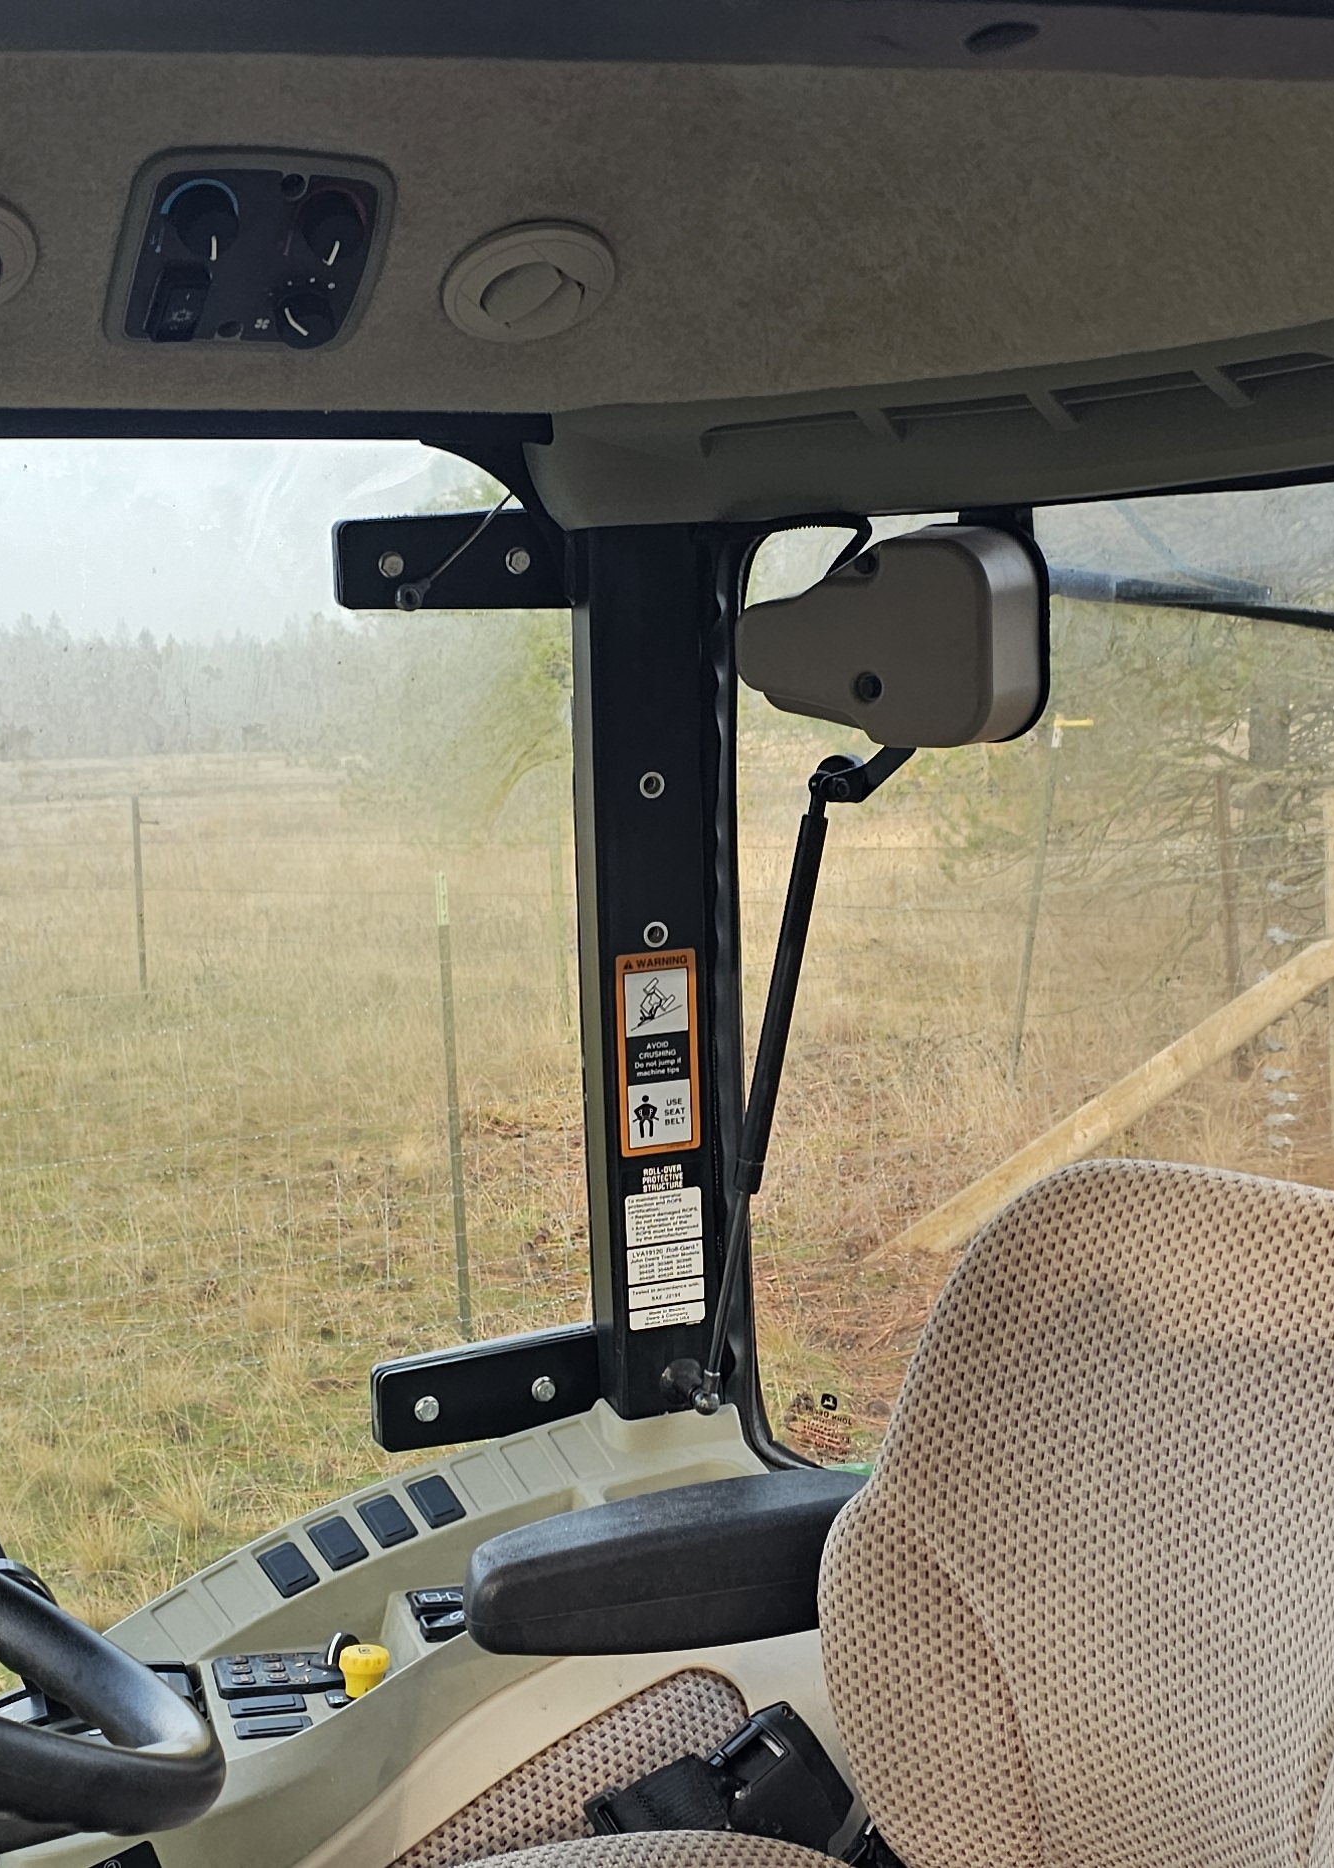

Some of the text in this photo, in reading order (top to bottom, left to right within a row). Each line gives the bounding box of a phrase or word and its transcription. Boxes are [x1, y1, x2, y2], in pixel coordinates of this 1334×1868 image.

[636, 955, 687, 968] WARNING
[646, 1041, 669, 1050] AVOID
[639, 1049, 676, 1059] CRUSHING
[658, 1059, 675, 1067] jump
[637, 1069, 665, 1077] machine
[666, 1098, 682, 1106] USE
[664, 1107, 685, 1116] SEAT
[665, 1117, 685, 1126] BELT
[643, 1164, 681, 1176] ROLL-OVER
[642, 1172, 683, 1184] PROTECTIVE
[643, 1180, 683, 1192] STRUCTURE
[632, 1249, 663, 1258] LVA19120
